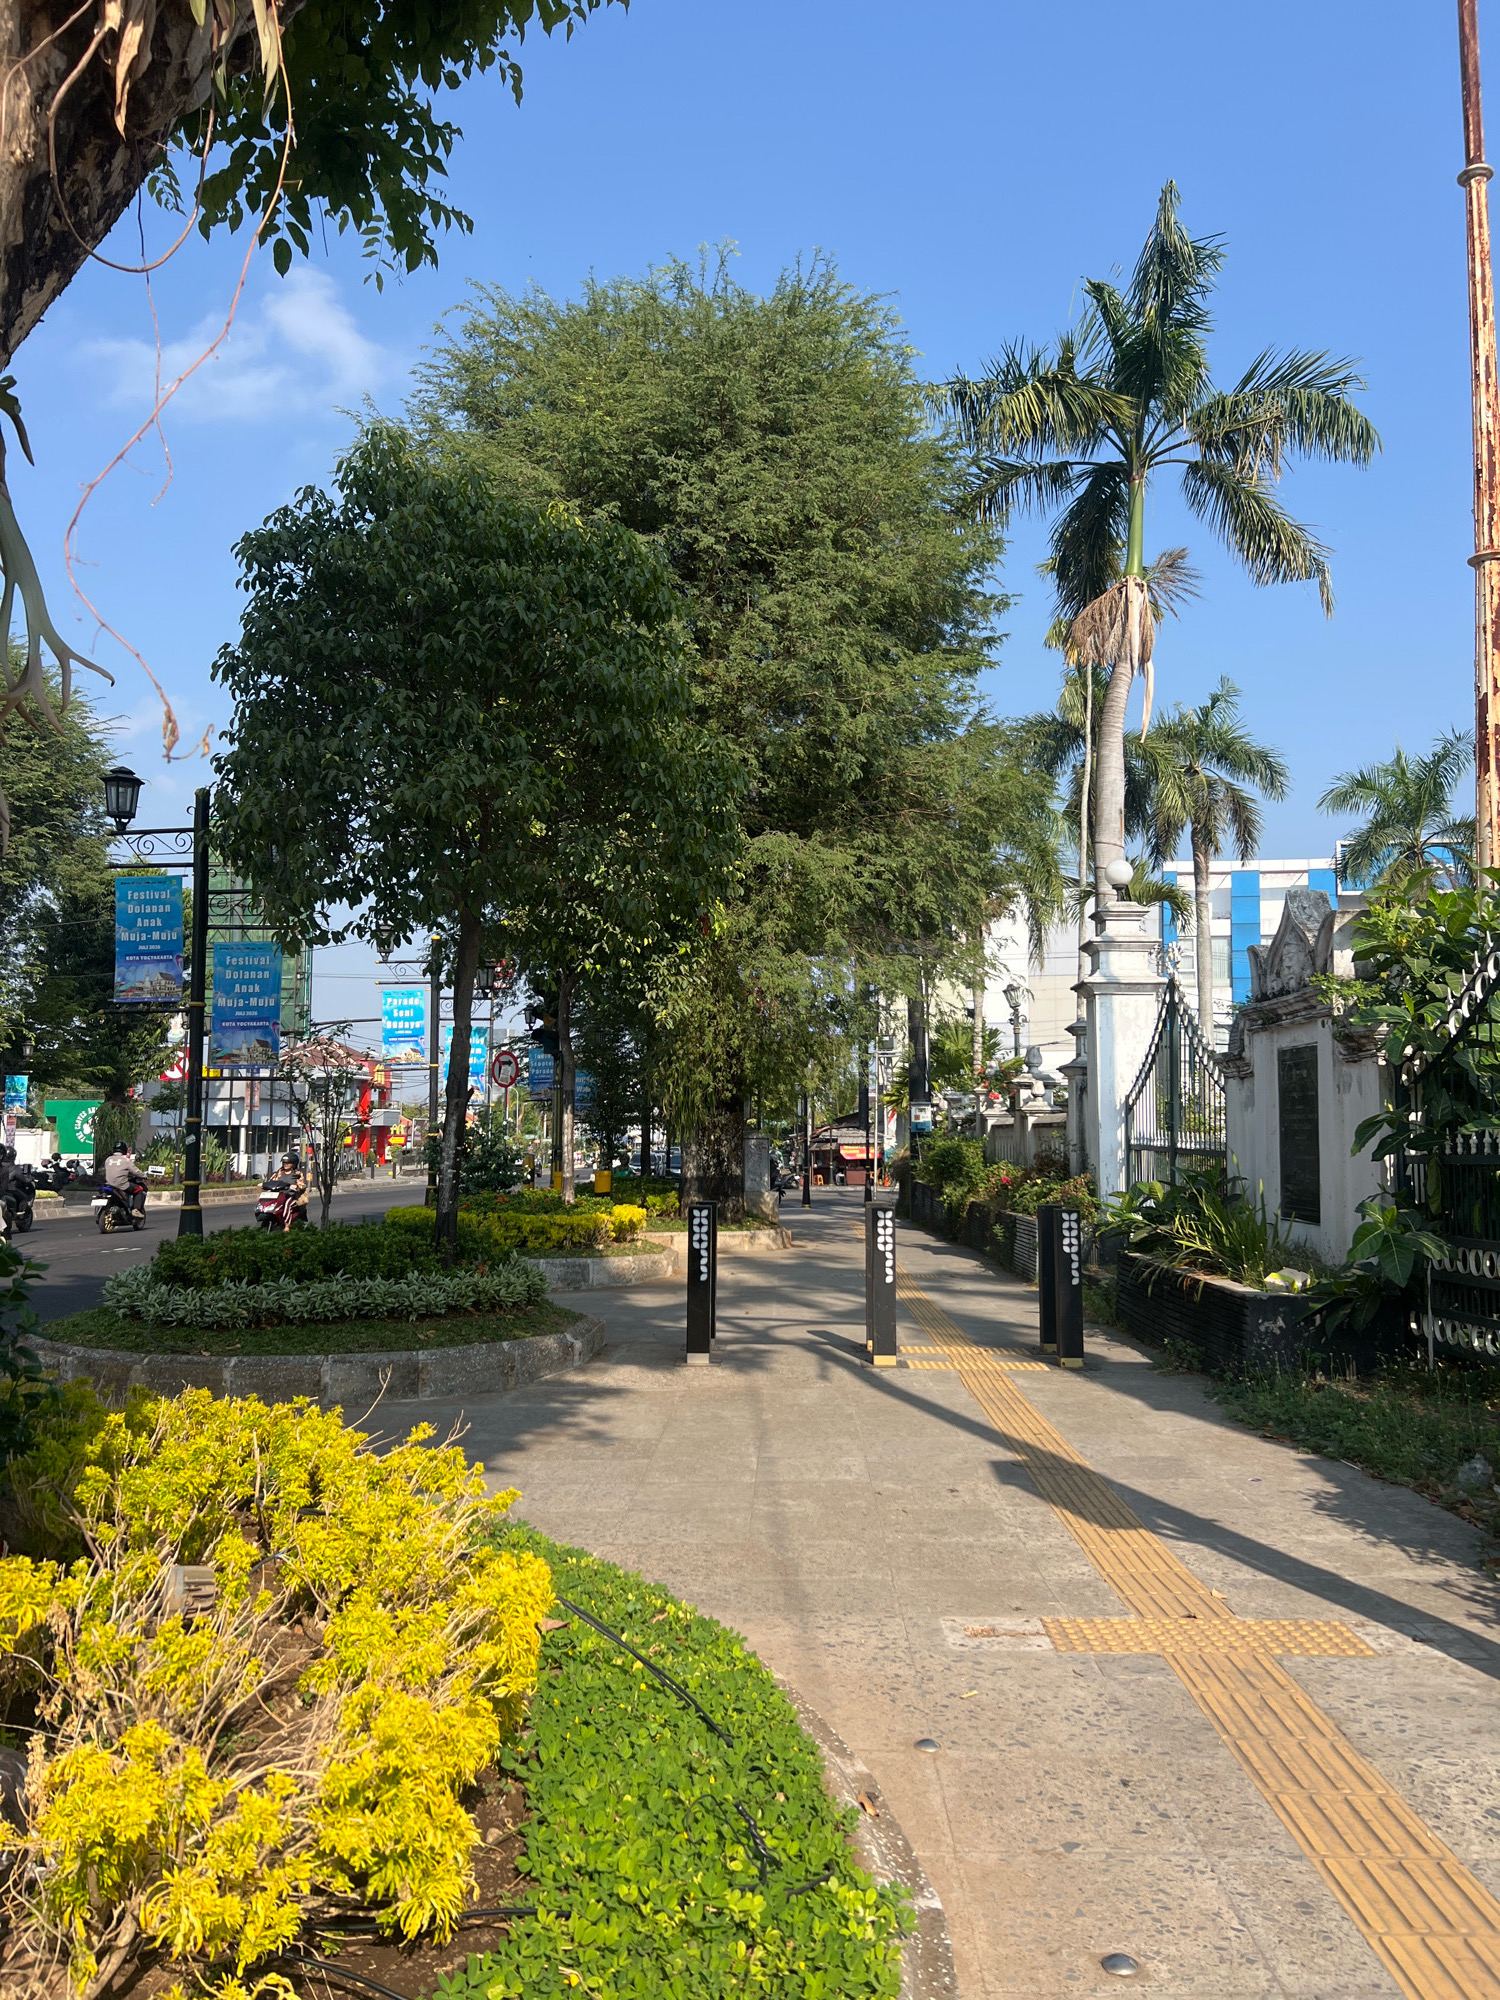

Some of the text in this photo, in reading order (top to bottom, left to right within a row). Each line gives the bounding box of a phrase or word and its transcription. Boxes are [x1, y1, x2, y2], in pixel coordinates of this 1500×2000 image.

[127, 889, 171, 900] Festival
[127, 904, 171, 914] Dolanan
[136, 917, 162, 927] Anak
[121, 931, 178, 941] Muja-Muju
[225, 955, 270, 966] Festival
[225, 969, 270, 980] Dolanan
[234, 983, 260, 993] Anak
[217, 997, 275, 1008] Muja-Muju
[386, 996, 420, 1006] Parade
[393, 1008, 414, 1017] Seni
[386, 1020, 421, 1029] Budaya
